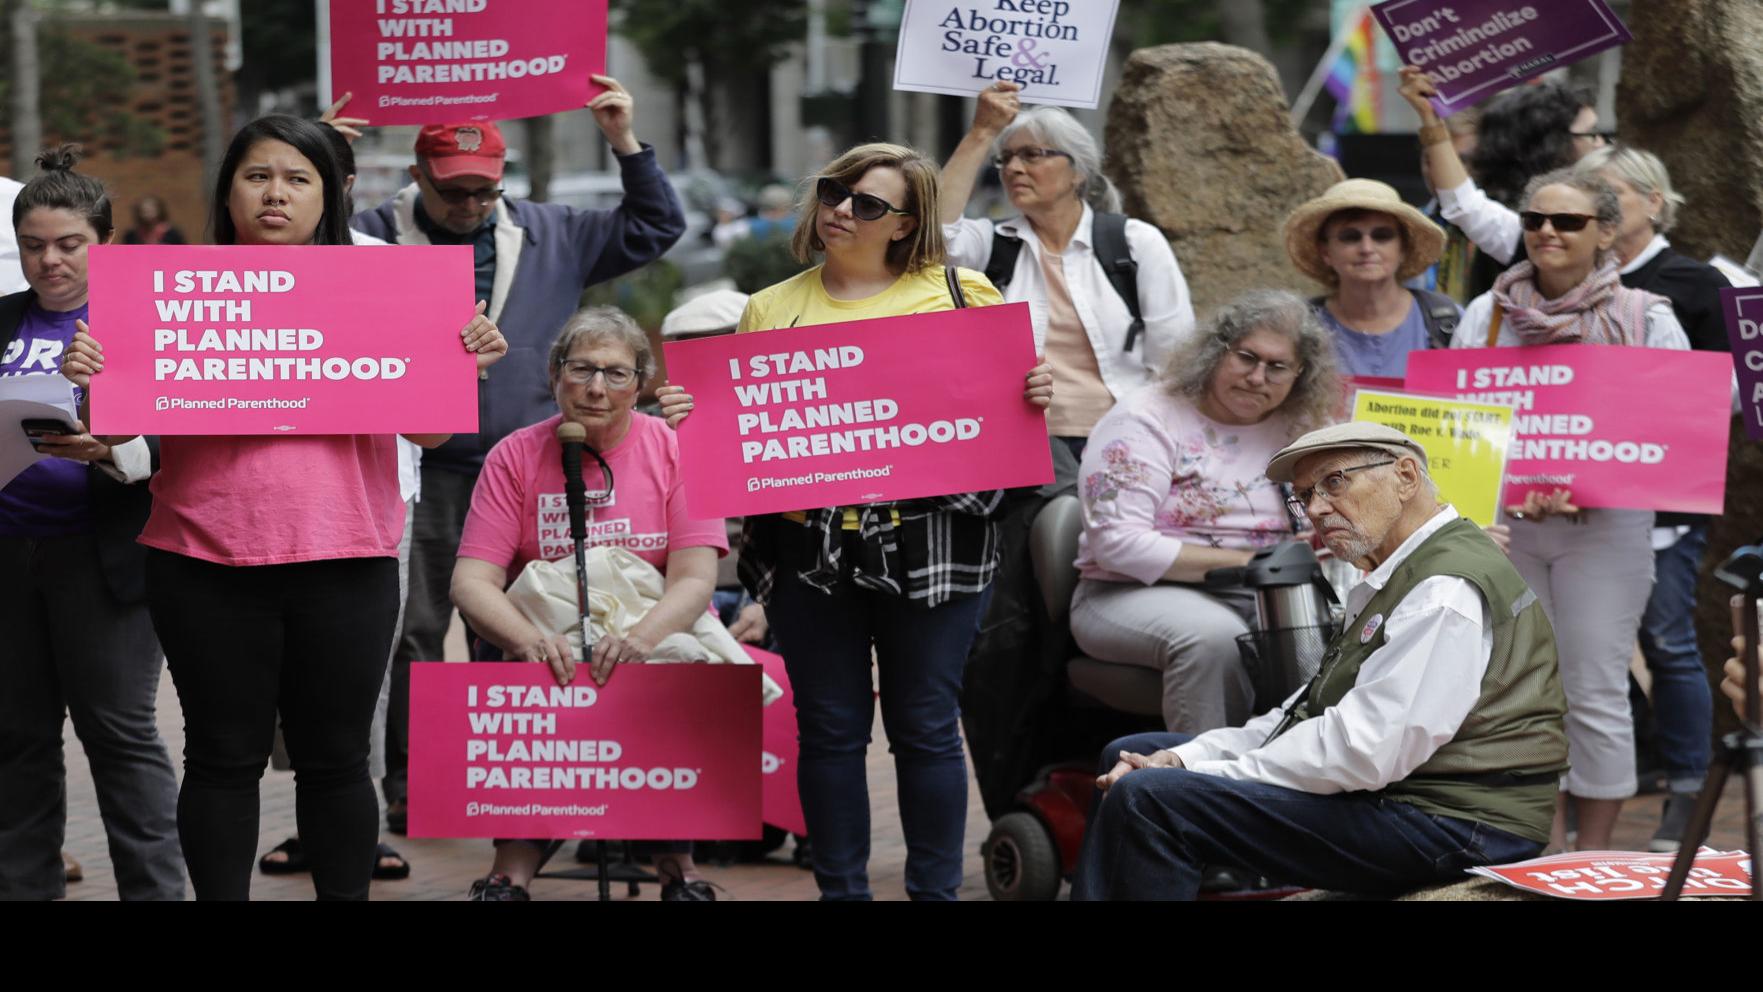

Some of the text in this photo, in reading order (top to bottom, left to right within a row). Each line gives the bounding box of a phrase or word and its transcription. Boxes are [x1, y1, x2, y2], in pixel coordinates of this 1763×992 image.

[392, 0, 488, 14] STAND
[993, 0, 1070, 23] Keep
[378, 19, 453, 37] WITH
[939, 7, 1079, 41] Abortion
[1393, 7, 1460, 43] Don't
[1408, 6, 1538, 66] Criminalize
[377, 39, 509, 60] PLANNED
[941, 31, 1049, 69] Safe &
[1427, 36, 1533, 84] Abortion
[378, 54, 566, 84] PARENTHOOD
[972, 57, 1060, 90] Legal.
[390, 93, 497, 106] Planned Parenthood
[154, 270, 295, 293] I STAND
[155, 300, 251, 321] WITH
[155, 329, 324, 351] PLANNED
[155, 357, 406, 381] PARENTHOOD
[729, 346, 865, 380] I STAND
[1457, 364, 1575, 389] I STAND
[171, 398, 307, 409] Planned Parenthood
[734, 379, 827, 407] WITH
[738, 399, 899, 435] PLANNED
[1366, 401, 1416, 416] Abortion
[1421, 407, 1439, 419] did
[1410, 424, 1432, 434] Roe
[1512, 414, 1594, 436] NNED
[742, 418, 981, 463] PARENTHOOD
[1509, 439, 1665, 464] ENTHOOD
[762, 467, 891, 489] Planned Parenthood
[541, 522, 626, 540] PLANED
[467, 685, 597, 707] I STAND
[468, 713, 556, 734] WITH
[467, 740, 622, 762] PLANNED
[467, 767, 697, 789] PARENTHOOD
[480, 803, 605, 816] Planned Parenthood
[1526, 866, 1628, 882] list
